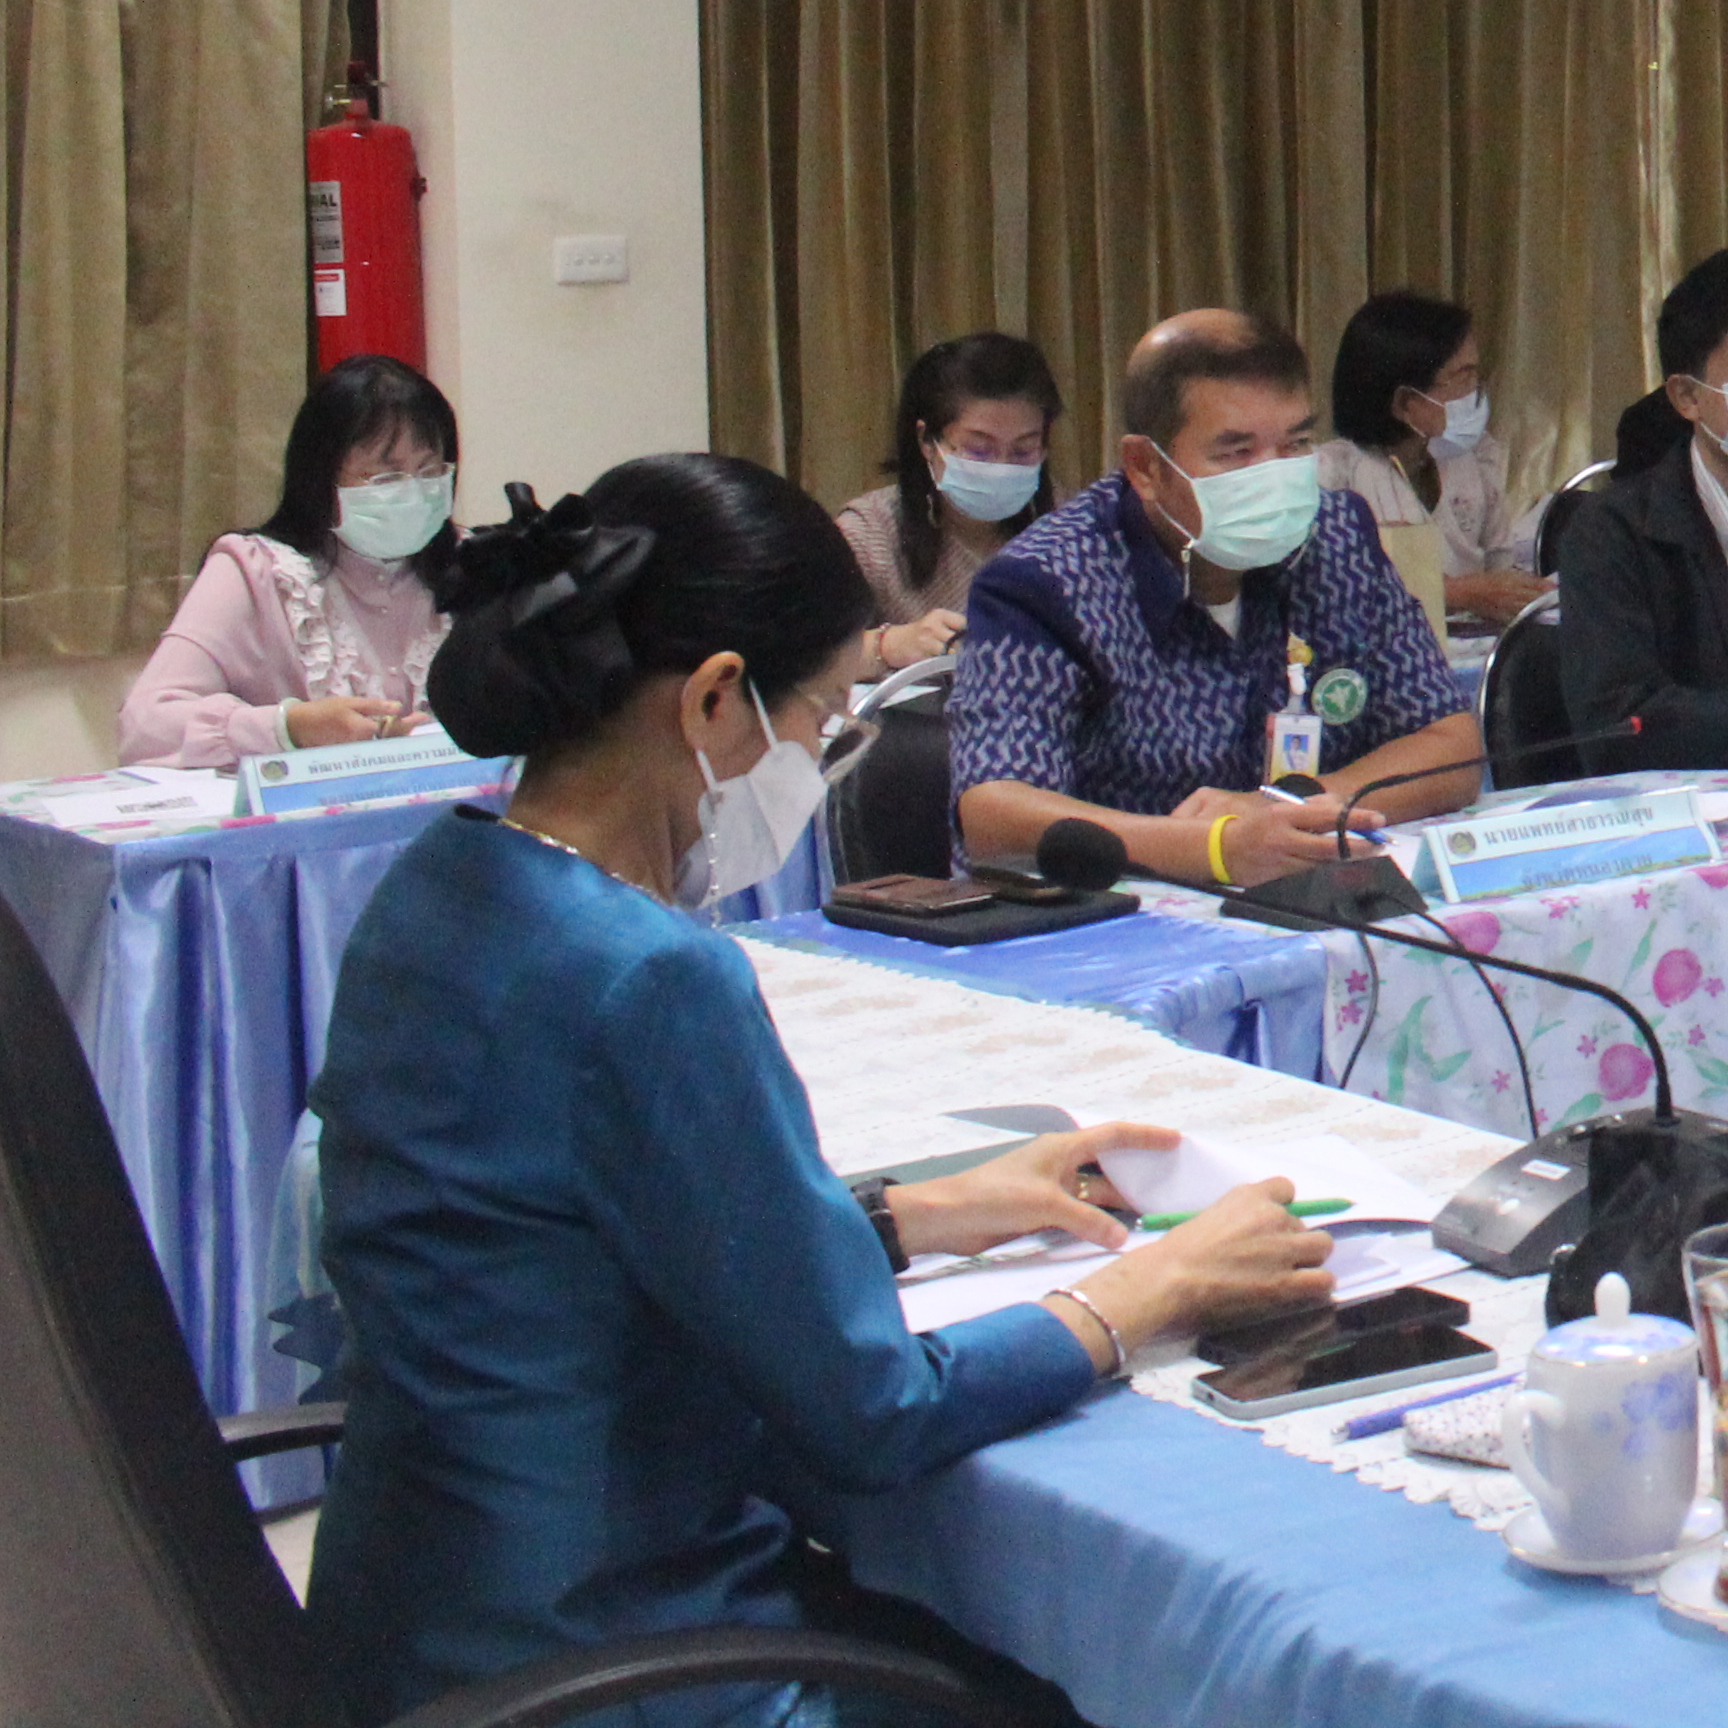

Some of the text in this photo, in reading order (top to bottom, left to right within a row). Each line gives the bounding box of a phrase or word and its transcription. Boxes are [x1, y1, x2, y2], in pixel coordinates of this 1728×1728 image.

[308, 746, 460, 775] พัฒนาสังคมและความม
[1483, 806, 1654, 846] นายแพทย์สาธารณสุข
